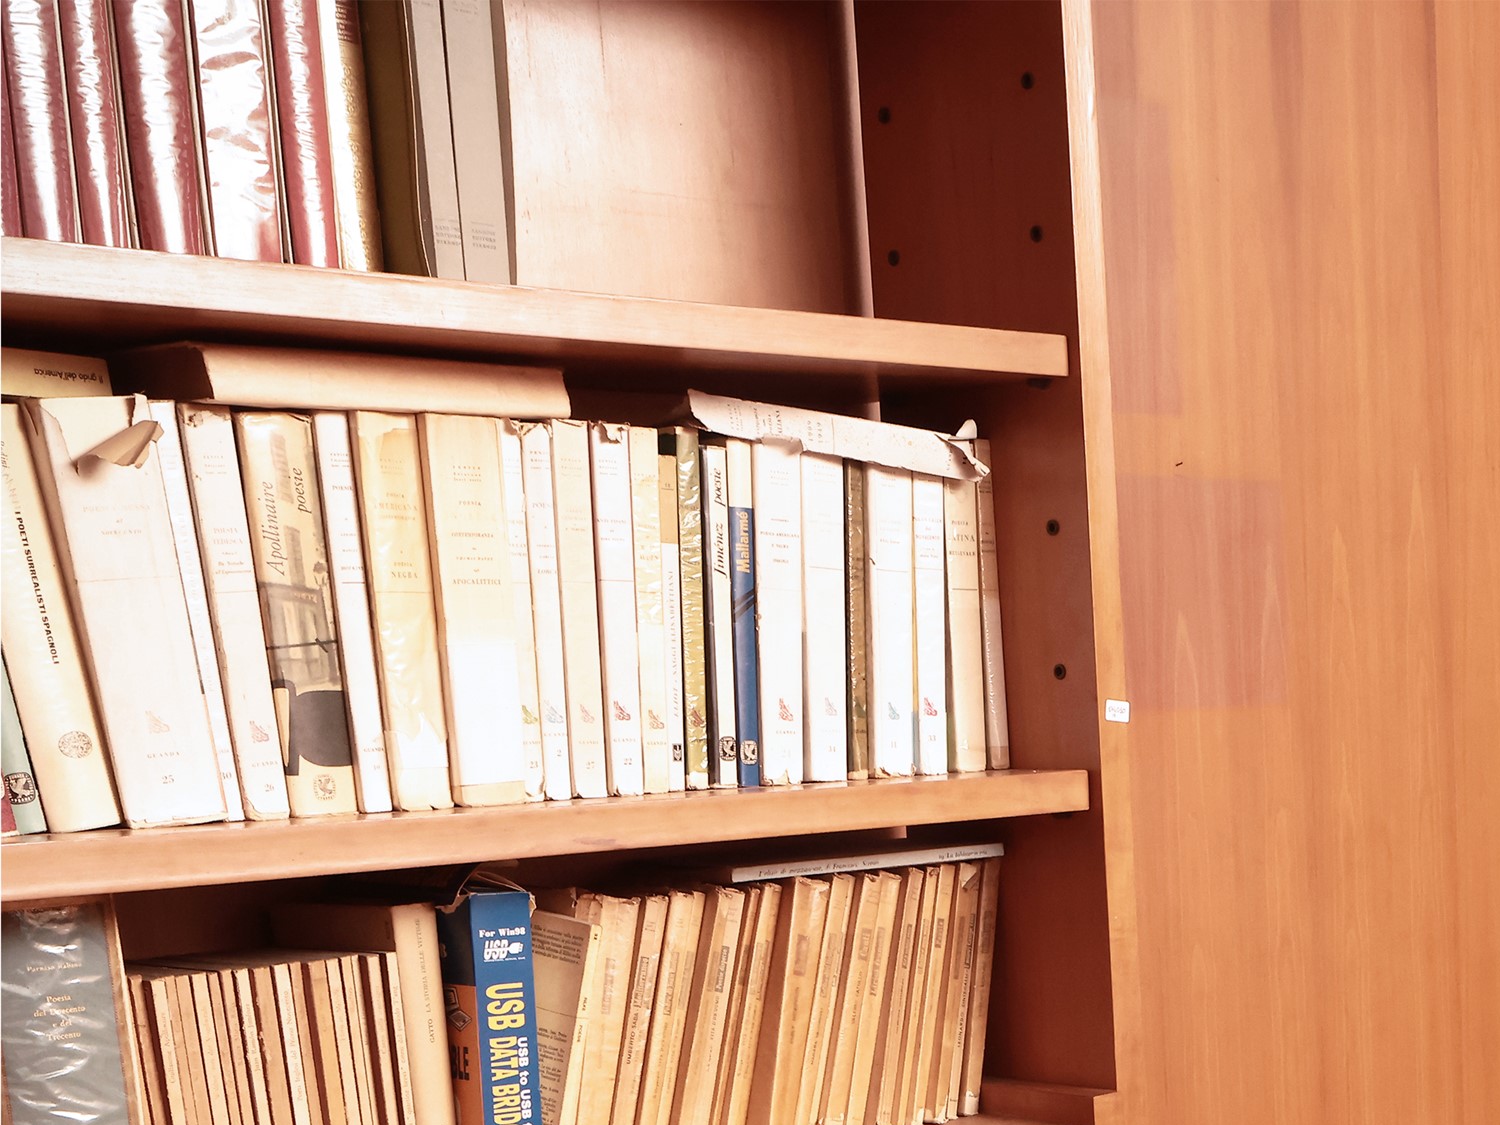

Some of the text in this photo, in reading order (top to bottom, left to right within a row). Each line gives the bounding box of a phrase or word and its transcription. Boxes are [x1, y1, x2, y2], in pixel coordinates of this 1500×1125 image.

[34, 368, 77, 381] dell'America
[78, 373, 97, 382] grido
[288, 467, 312, 514] poesie
[258, 481, 288, 576] Apollinaire
[710, 468, 727, 578] Jiménez poesie
[736, 511, 750, 573] Mallarmé
[950, 534, 975, 542] ATINA
[16, 517, 30, 547] POETI
[24, 548, 46, 614] SURREALISTI
[41, 615, 60, 665] SPAGNOLI
[624, 757, 632, 766] 22
[162, 775, 174, 784] 25
[415, 918, 424, 949] VITTIME
[479, 927, 526, 938] For Win98
[483, 939, 508, 960] USB
[46, 995, 72, 1003] Poesia
[423, 976, 431, 1003] STORIA
[281, 989, 292, 1024] Novecento
[426, 1004, 432, 1013] LA
[485, 982, 525, 1030] USB
[60, 1019, 72, 1027] del
[516, 1037, 529, 1067] USB
[626, 1031, 635, 1065] UMBERTO
[631, 1013, 639, 1031] SABA
[488, 1035, 520, 1081] DATA
[519, 1070, 531, 1086] to
[519, 1089, 531, 1119] USB
